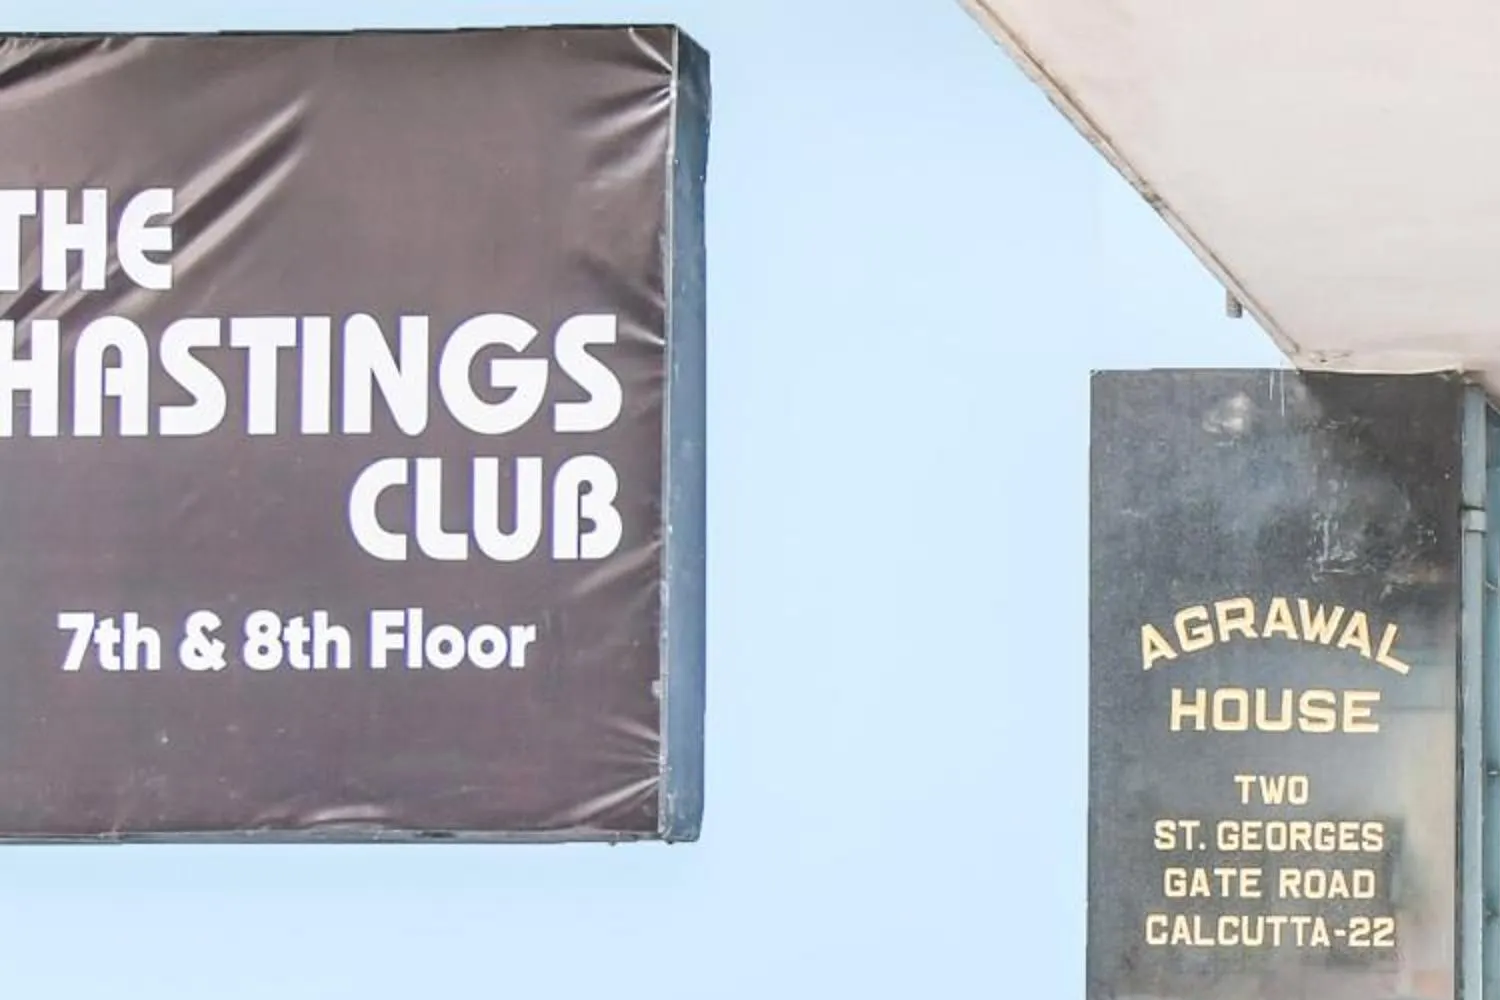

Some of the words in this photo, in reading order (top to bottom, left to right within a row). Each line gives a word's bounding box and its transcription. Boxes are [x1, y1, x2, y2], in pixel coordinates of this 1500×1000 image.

[0, 188, 174, 292] THE
[0, 313, 624, 437] HASTINGS
[349, 455, 624, 561] CLUB
[58, 611, 161, 671] 7th
[179, 610, 226, 671] &
[243, 610, 352, 671] 8th
[371, 607, 537, 670] Floor
[1140, 596, 1411, 675] AGRAWAL
[1169, 687, 1382, 734] HOUSE
[1233, 774, 1310, 805] TWO
[1153, 819, 1207, 851] ST.
[1216, 820, 1385, 852] GEORGES
[1163, 866, 1263, 899] GATE
[1278, 868, 1376, 900] ROAD
[1145, 913, 1396, 948] CALCUTTA-22
